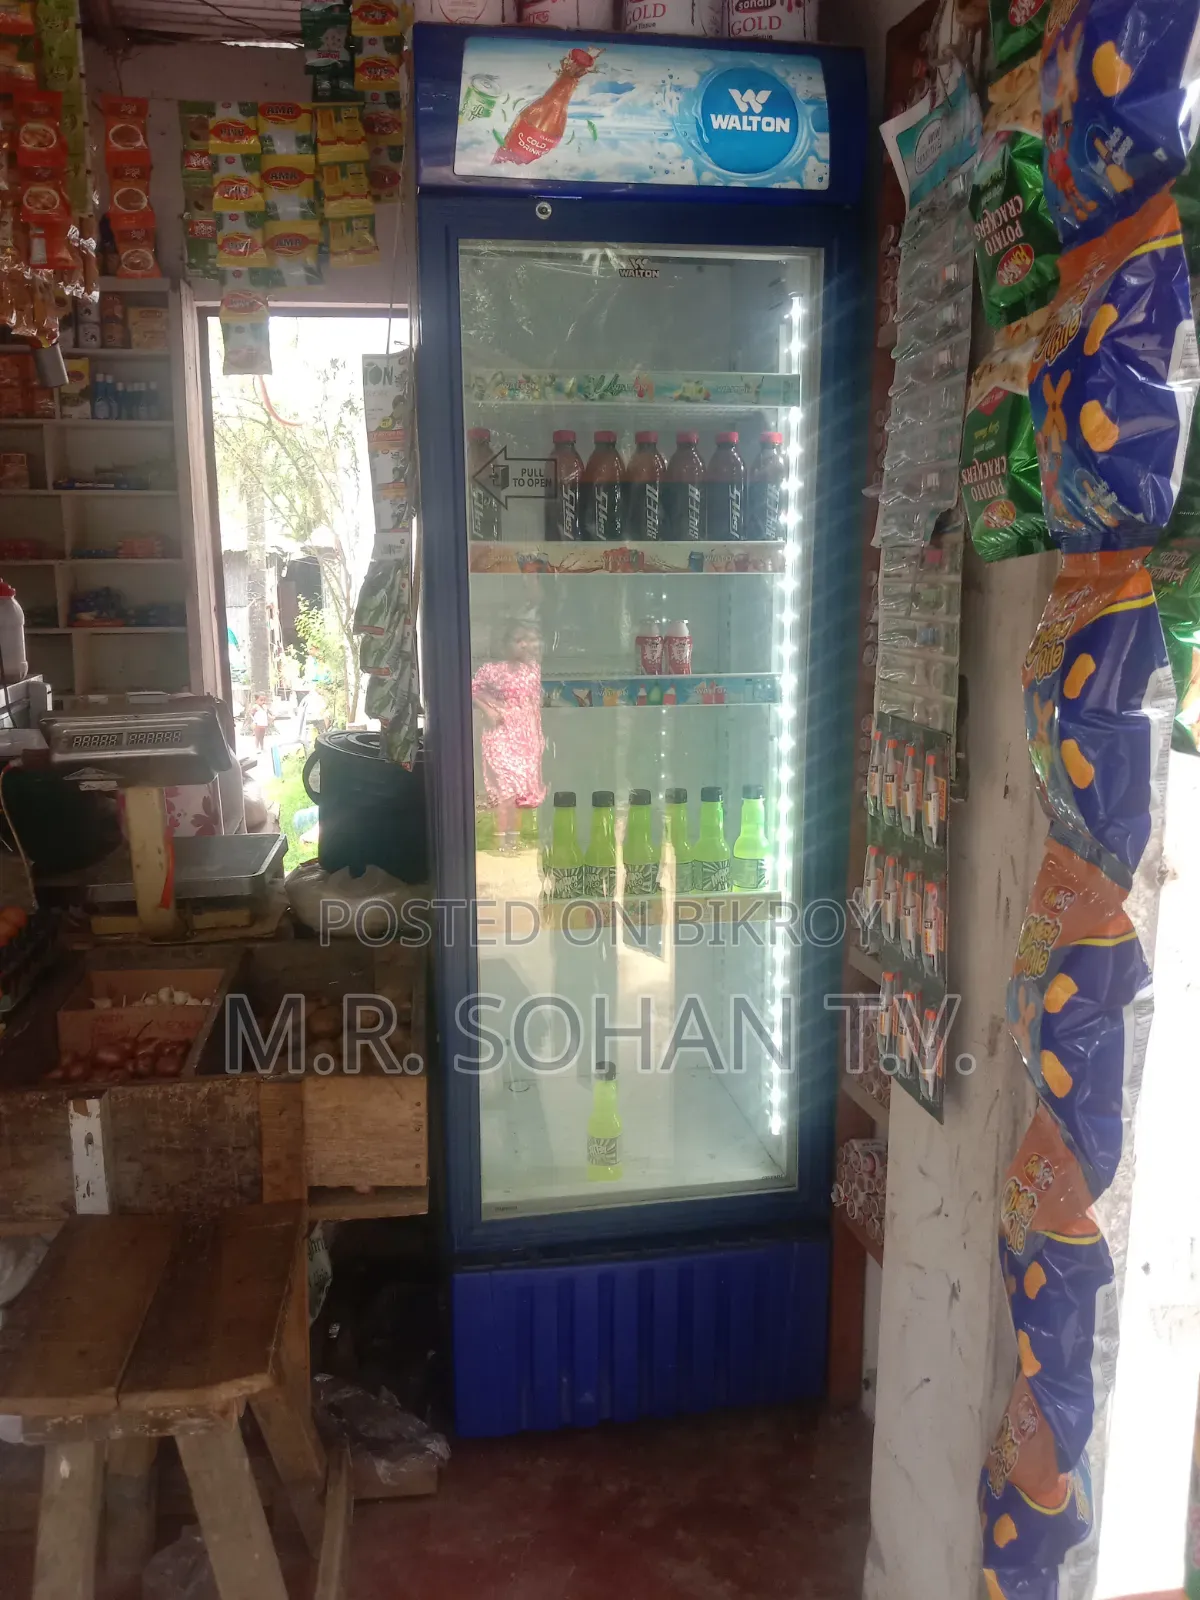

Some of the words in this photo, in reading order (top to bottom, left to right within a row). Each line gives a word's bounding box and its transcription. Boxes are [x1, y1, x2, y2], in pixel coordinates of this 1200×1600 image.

[625, 3, 667, 26] GOLD
[730, 15, 783, 37] GOLD
[710, 113, 790, 133] WALTON
[526, 136, 547, 149] COLD
[974, 195, 1024, 242] CRACKERS
[985, 219, 1024, 256] POTATO
[619, 268, 660, 278] WALTON
[521, 468, 544, 477] PULL
[961, 456, 1007, 485] CRACKERS
[513, 478, 526, 487] TO
[527, 478, 552, 487] OPEN
[971, 478, 1006, 502] POTATO
[646, 484, 659, 540] SPEED
[688, 484, 700, 540] SPEED
[765, 484, 780, 540] SPEED
